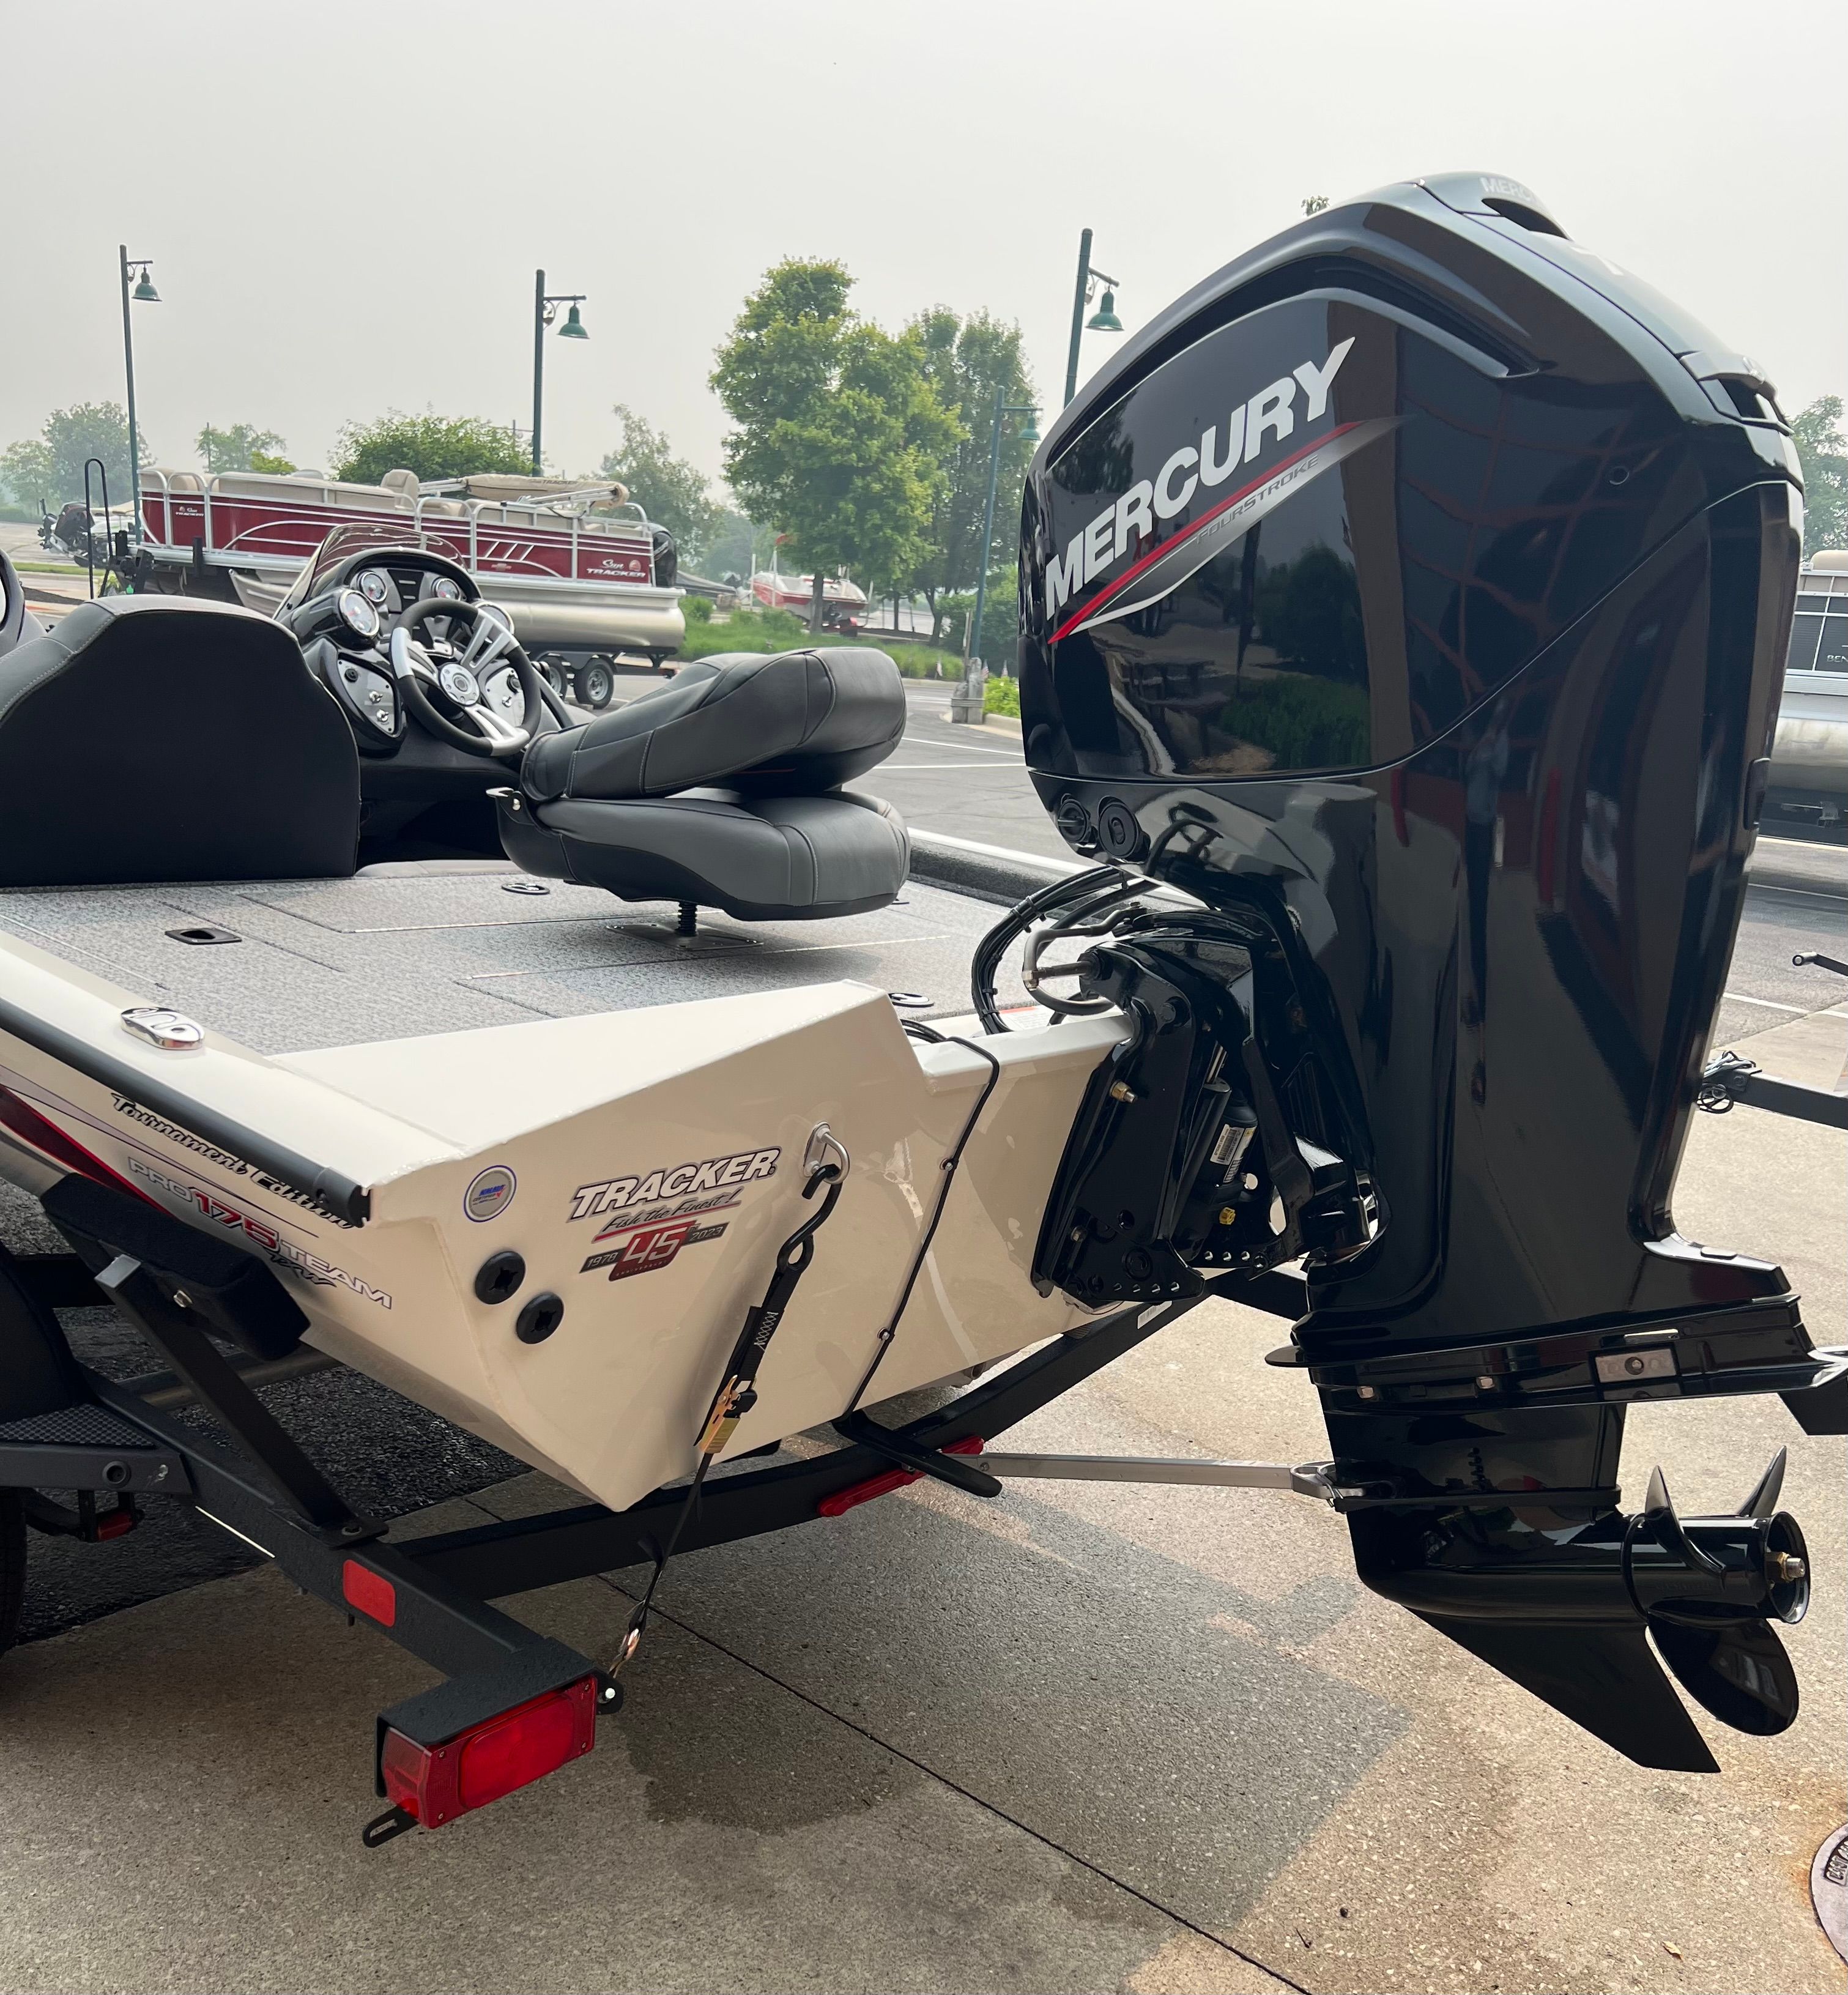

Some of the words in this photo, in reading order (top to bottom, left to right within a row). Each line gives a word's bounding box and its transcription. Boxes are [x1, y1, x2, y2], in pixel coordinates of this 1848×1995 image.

[1046, 336, 1356, 621] MERCURY
[1197, 454, 1319, 544] FOURSTROKE
[587, 568, 646, 578] TRACKER
[601, 559, 624, 569] Sun
[111, 1092, 249, 1175] Tournament
[250, 1165, 354, 1229] Edition
[570, 1147, 782, 1220] TRACKER
[128, 1156, 193, 1203] PRO
[187, 1186, 281, 1253] 175
[280, 1238, 392, 1310] TEAM
[587, 1252, 617, 1268] 1978
[623, 1226, 688, 1265] 45
[691, 1225, 724, 1242] 2023
[602, 1211, 642, 1232] Fish
[644, 1206, 670, 1222] the
